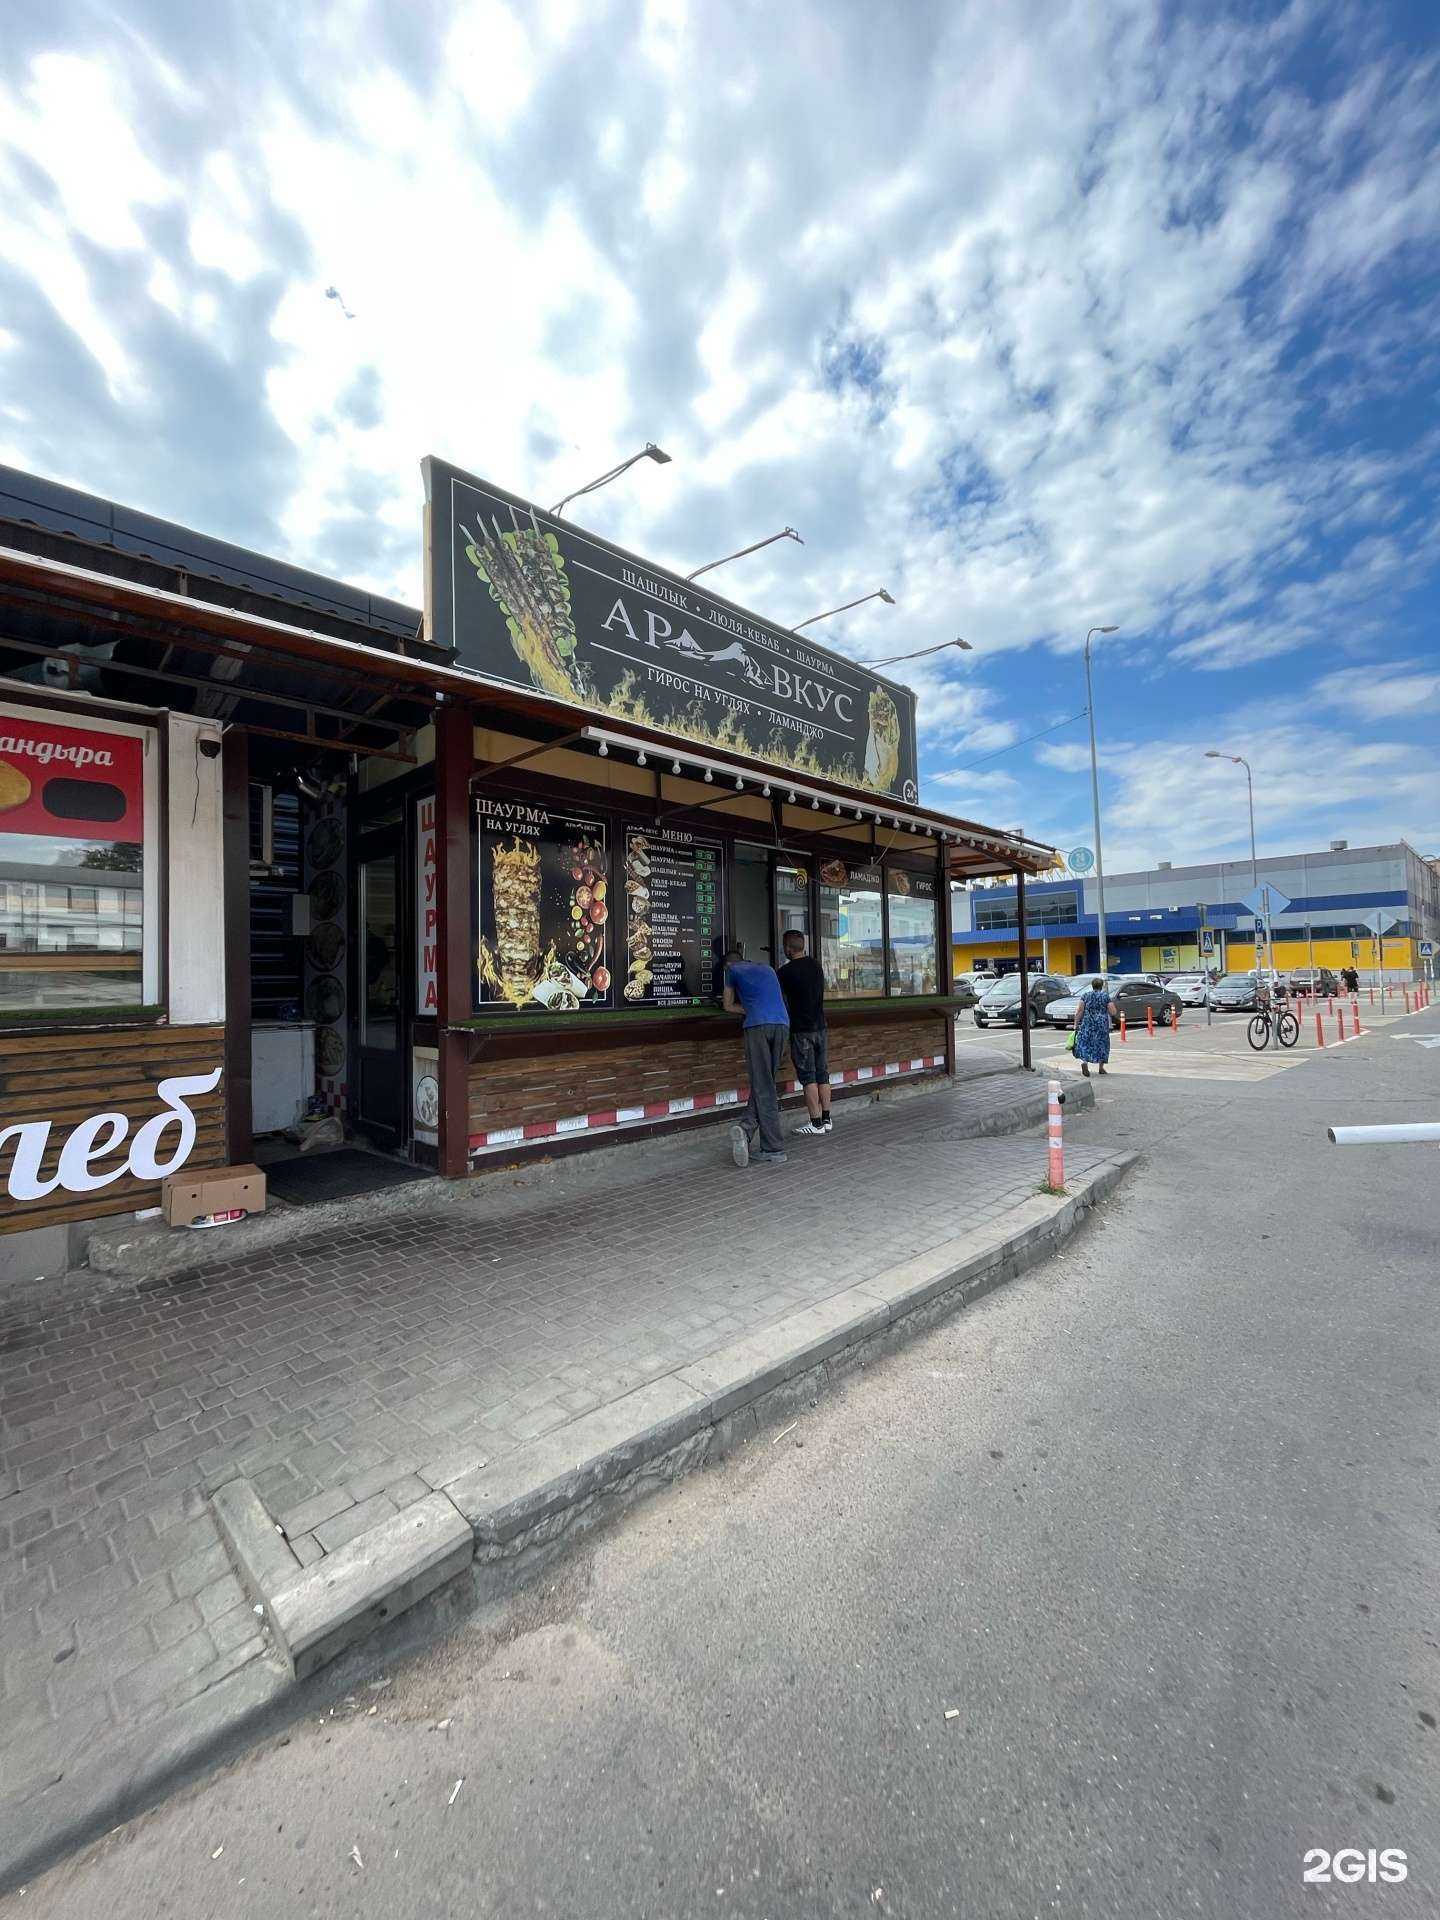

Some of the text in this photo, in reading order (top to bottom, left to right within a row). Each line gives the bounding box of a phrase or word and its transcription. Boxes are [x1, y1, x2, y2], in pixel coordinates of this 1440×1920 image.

[622, 568, 835, 676] ШАШЛЫК ЛЮЛЯ-КЕБАБ ШАУРМА
[647, 667, 824, 740] ГИРОС НА УГЛЯХ ЛАМАНДЖО
[771, 664, 854, 723] ВКУС
[475, 799, 550, 824] ШАУРМА
[486, 819, 540, 836] НА УГЛЯХ
[662, 829, 693, 842] МЕНЮ
[421, 804, 438, 1009] ШАУРМА
